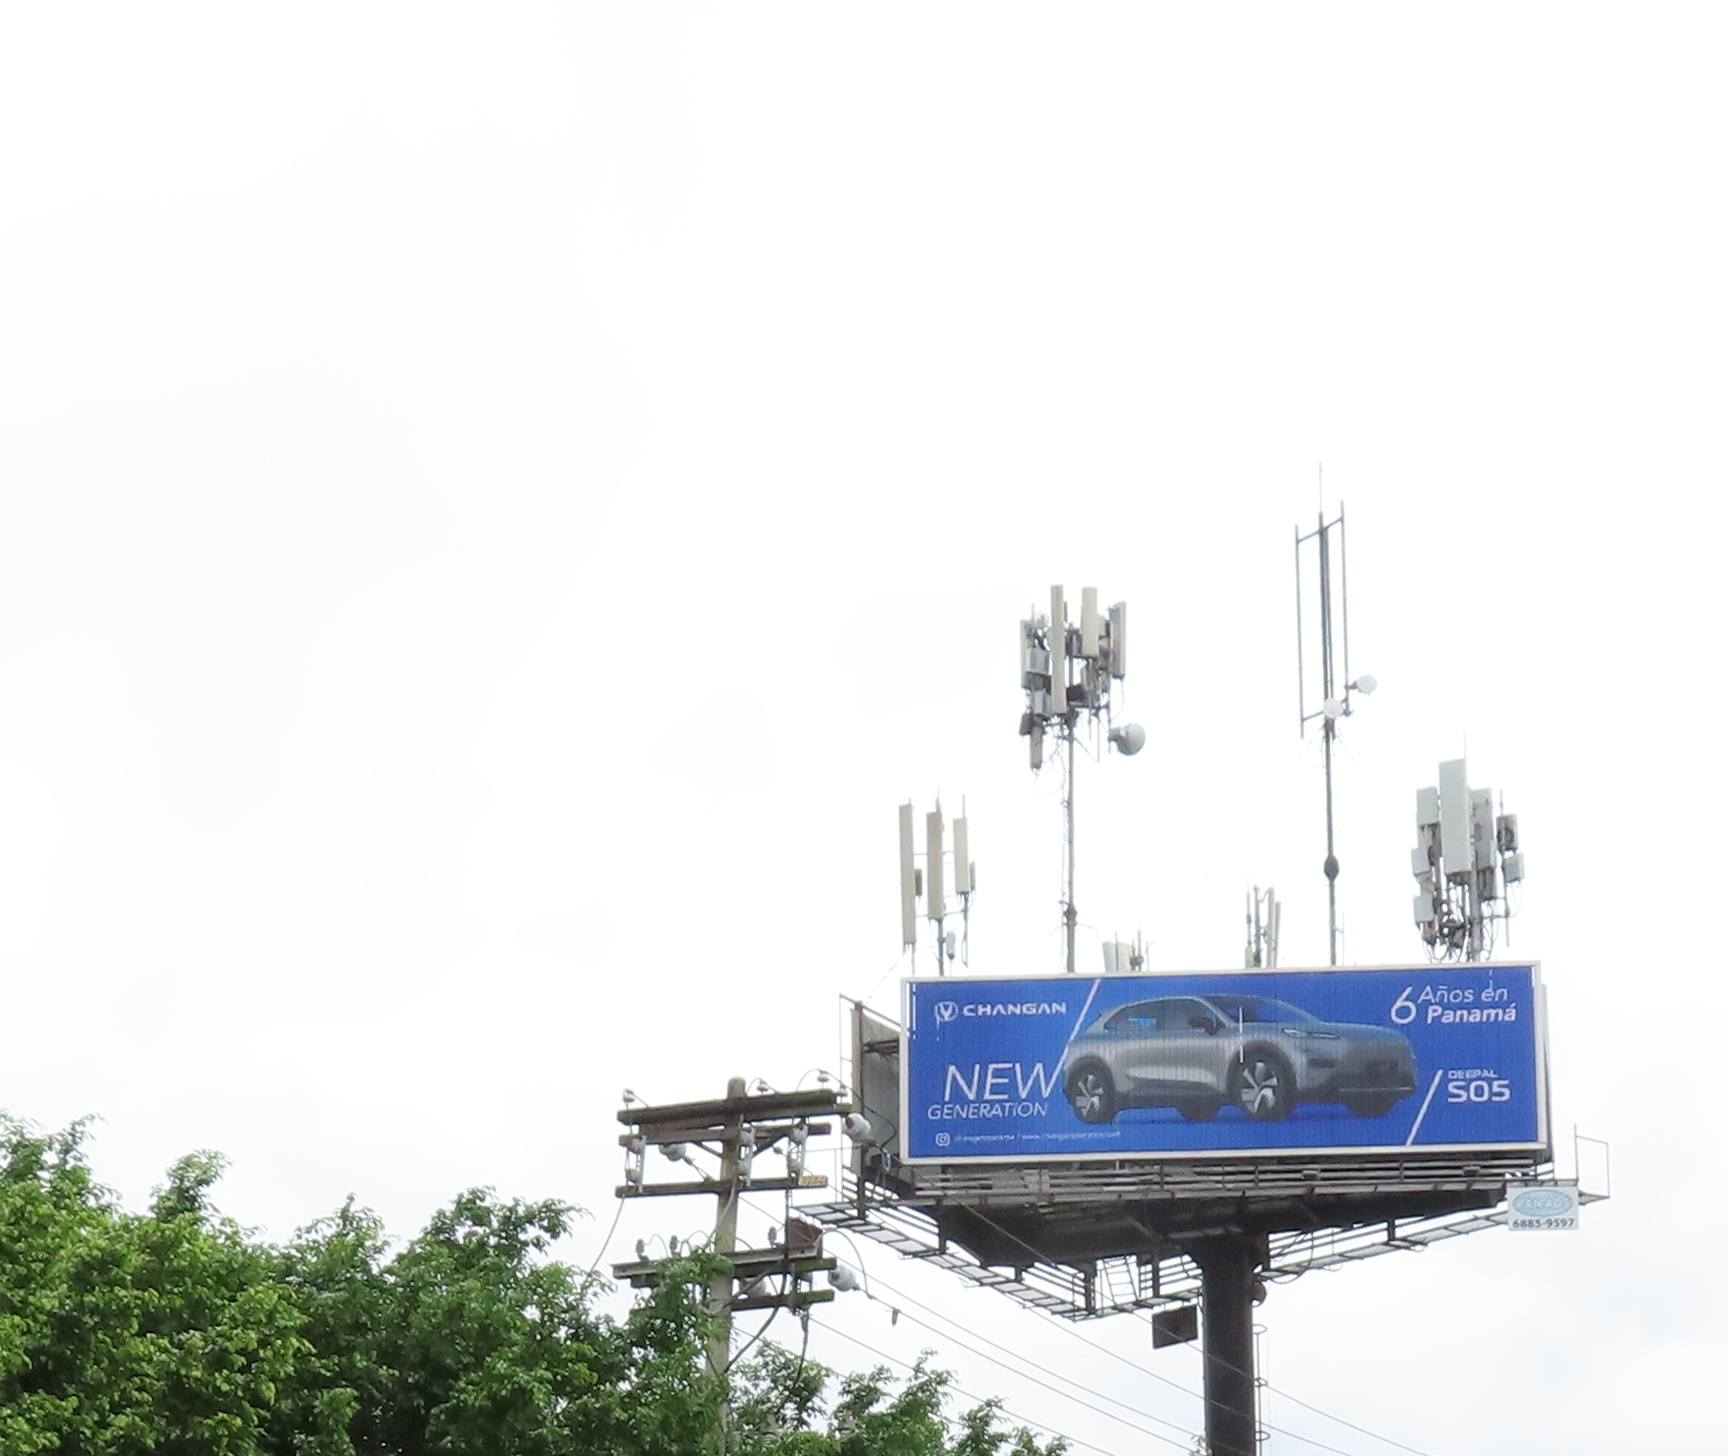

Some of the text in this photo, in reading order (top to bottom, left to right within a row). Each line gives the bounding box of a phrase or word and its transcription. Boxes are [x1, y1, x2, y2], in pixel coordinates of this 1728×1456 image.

[962, 1002, 1067, 1016] CHANGAN
[1390, 984, 1509, 1024] 6 Años en
[1426, 1002, 1517, 1024] Panamá
[944, 1062, 1053, 1102] NEW
[1447, 1080, 1511, 1103] S05
[927, 1101, 1048, 1120] GENERATION
[1513, 1218, 1575, 1228] 6885-9597
